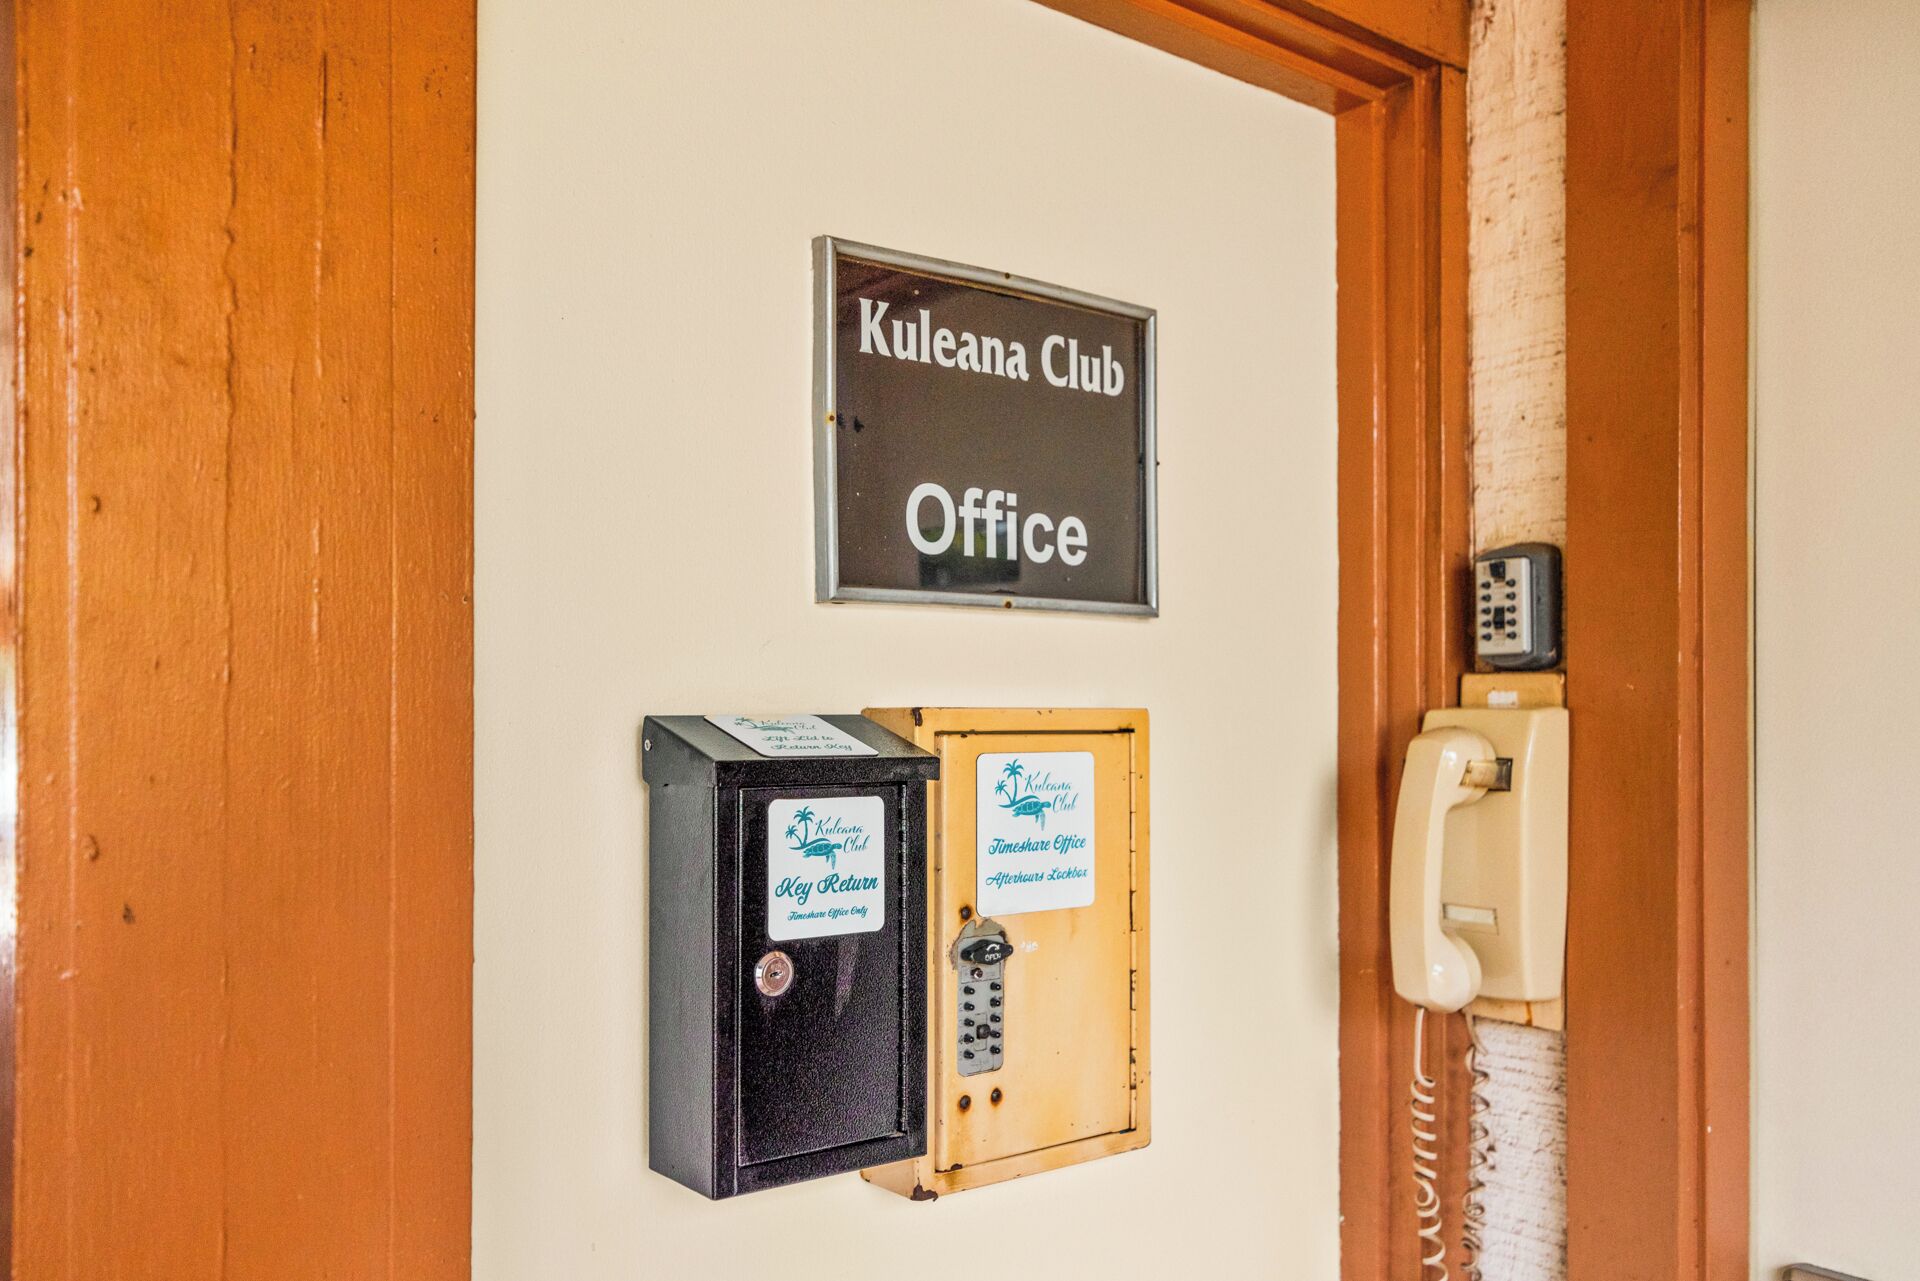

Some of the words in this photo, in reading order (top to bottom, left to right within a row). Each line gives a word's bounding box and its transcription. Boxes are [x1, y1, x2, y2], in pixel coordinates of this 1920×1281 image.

[859, 297, 1029, 382] Kuleana
[1041, 334, 1125, 396] Club
[905, 482, 1088, 566] Office
[1024, 770, 1072, 793] Kuleana
[1053, 792, 1079, 813] Club
[815, 816, 864, 836] Kuleana
[843, 834, 870, 853] Club
[988, 837, 1050, 855] Timeshare
[1053, 834, 1086, 854] Office
[985, 871, 1045, 889] Afterhours
[1047, 866, 1088, 881] Lockbox
[775, 876, 813, 905] Key
[817, 873, 879, 894] Return
[787, 910, 826, 921] Timeshare
[828, 907, 849, 919] Office
[850, 905, 868, 918] Only
[985, 953, 1001, 961] OPEN
